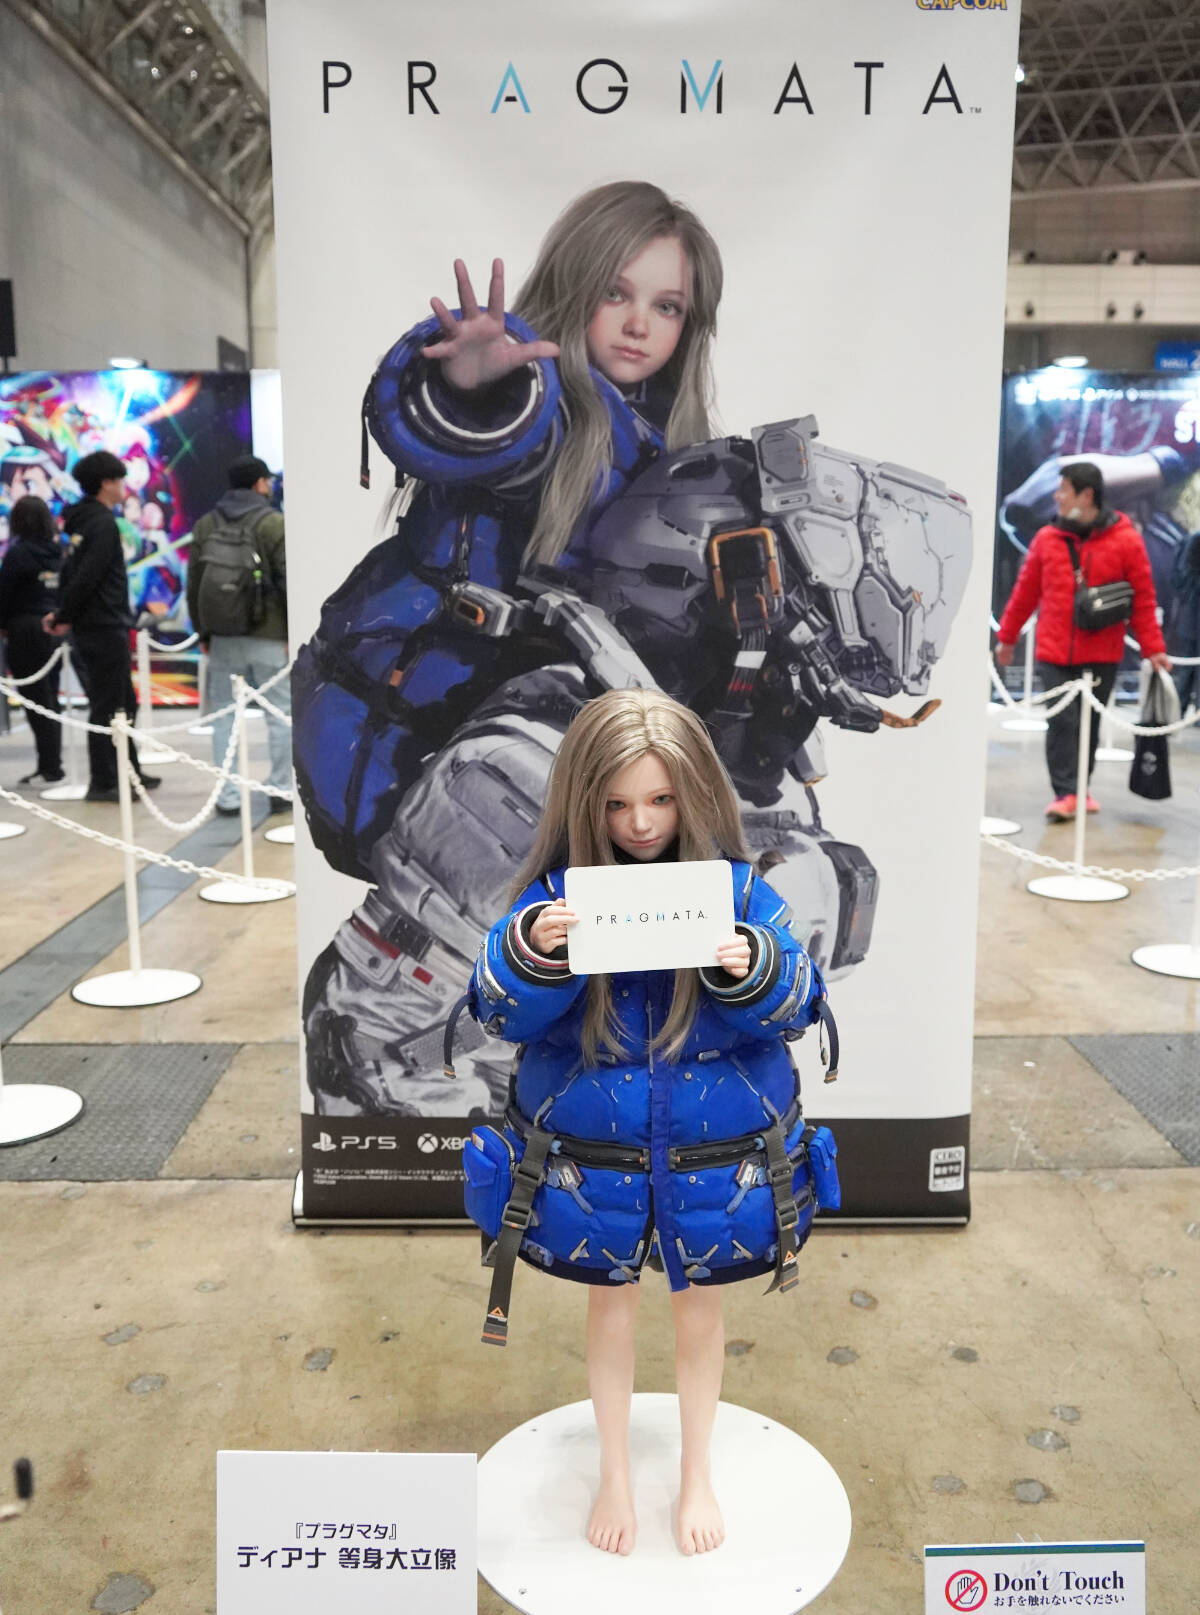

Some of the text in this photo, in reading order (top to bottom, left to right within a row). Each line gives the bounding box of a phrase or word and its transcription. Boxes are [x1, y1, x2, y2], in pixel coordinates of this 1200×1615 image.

[321, 58, 964, 115] PRAGMATA
[596, 909, 705, 926] PRAGMATA
[341, 1136, 397, 1150] PS5
[295, 1522, 397, 1540] 『プラグマタ』
[237, 1546, 457, 1570] ディアナ 等身大立像
[993, 1570, 1125, 1592] Don't Touch
[993, 1594, 1126, 1607] お手を触れないでください
